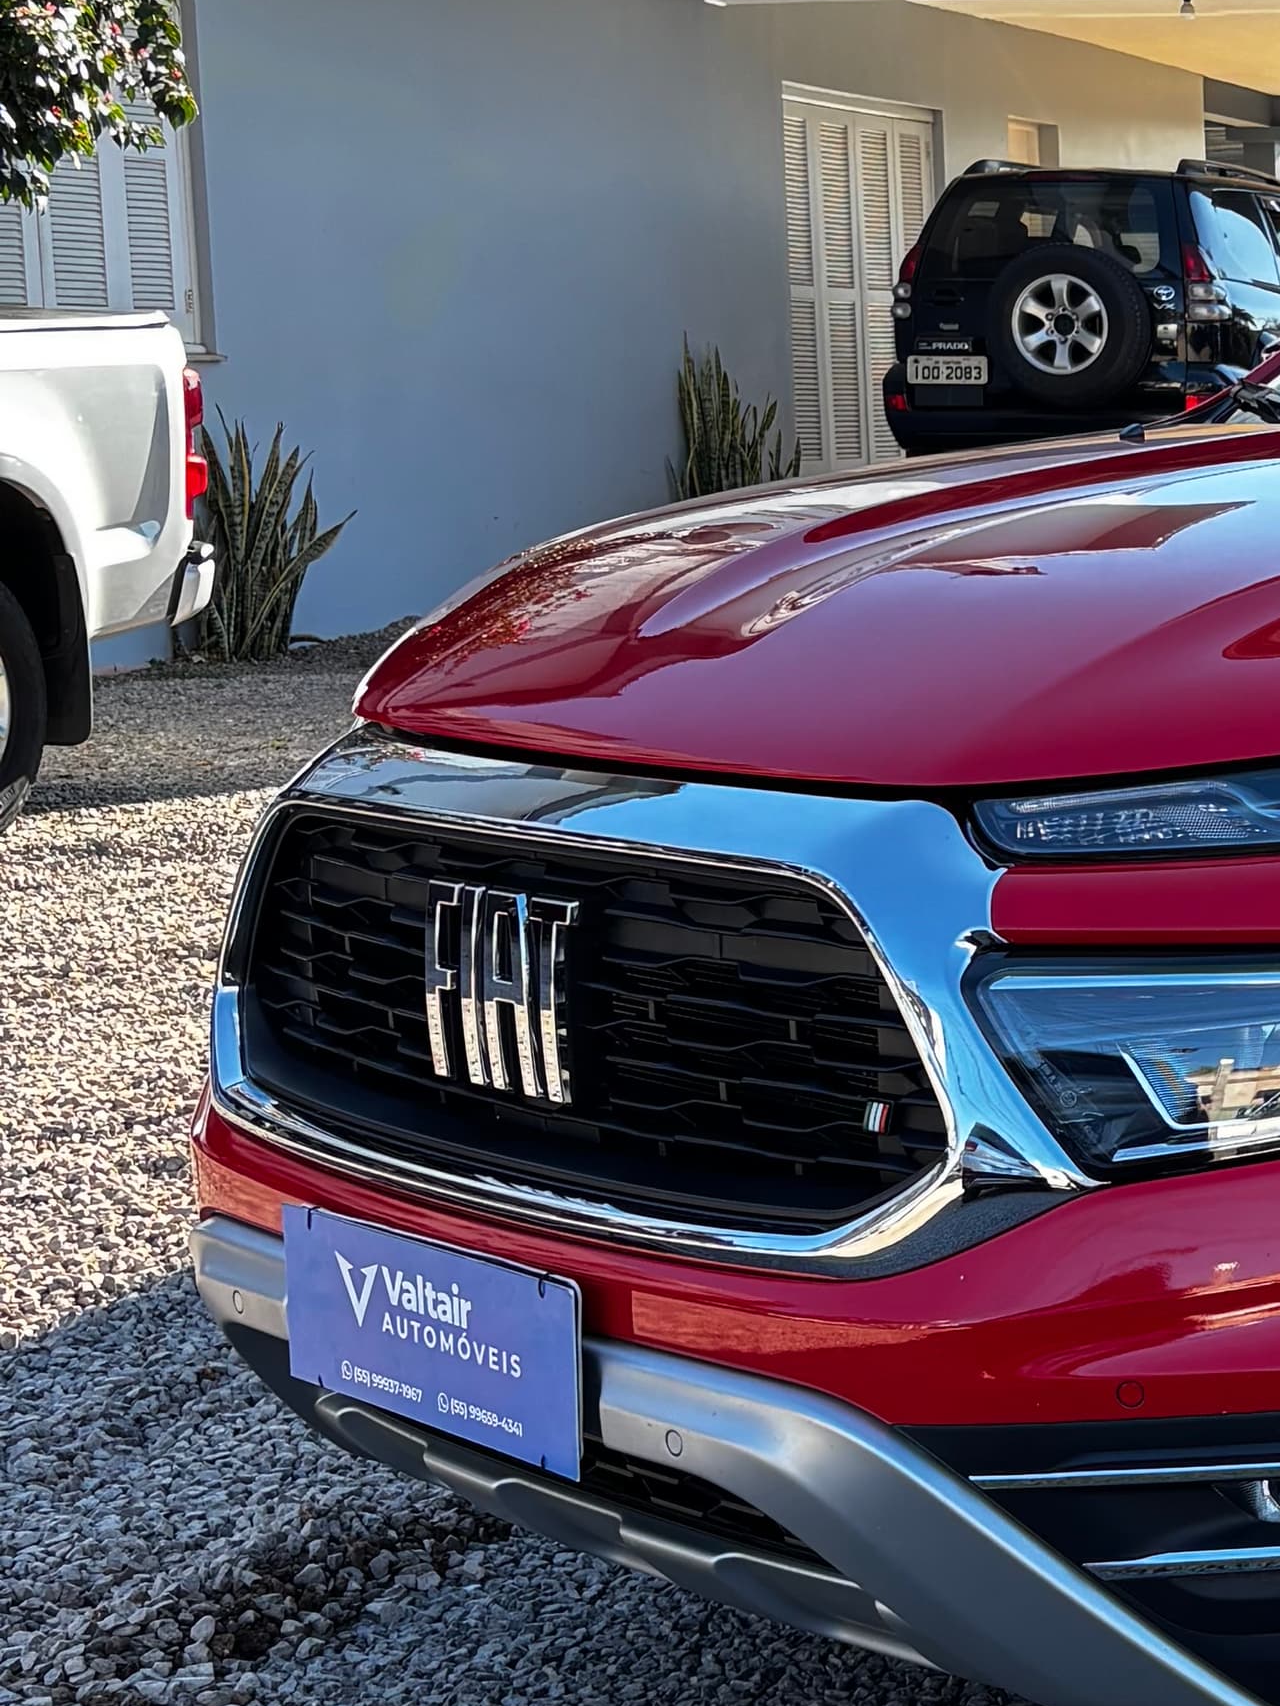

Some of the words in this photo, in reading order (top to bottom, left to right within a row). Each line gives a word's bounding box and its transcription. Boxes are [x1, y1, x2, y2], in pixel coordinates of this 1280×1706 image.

[932, 341, 969, 350] PRADO
[424, 878, 580, 1105] FIAT
[380, 1265, 472, 1330] Valtair
[381, 1311, 522, 1379] AUTOMÓVEIS
[353, 1366, 370, 1388] (55)
[450, 1397, 467, 1420] (55)
